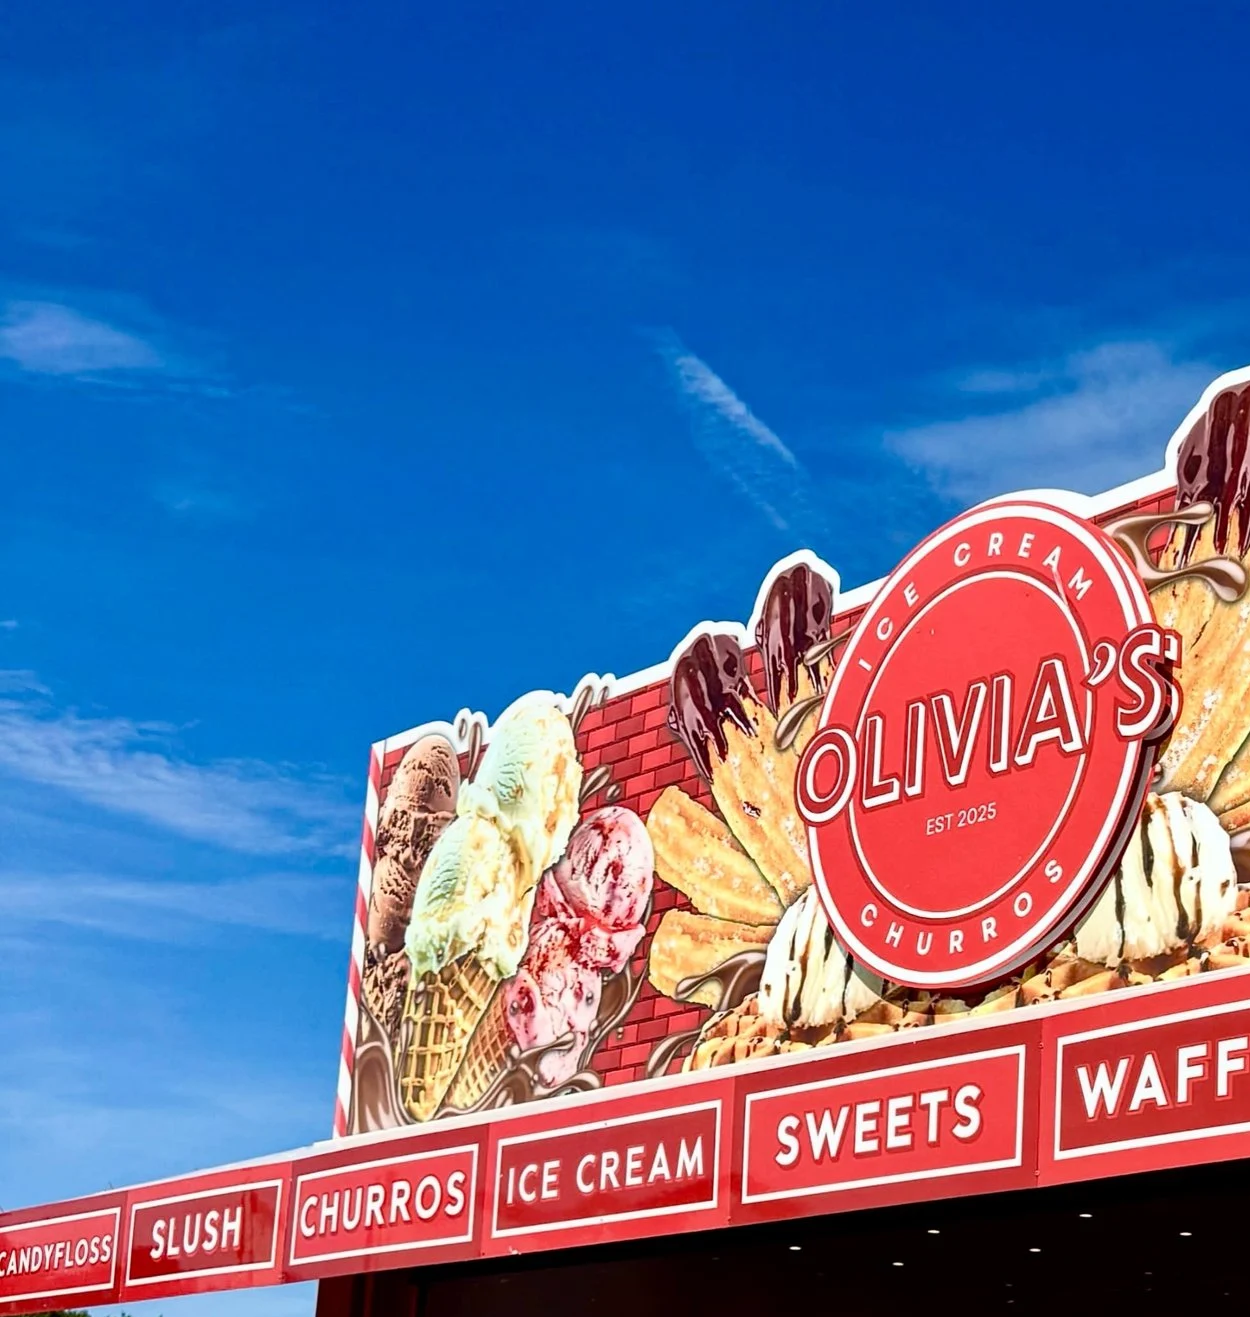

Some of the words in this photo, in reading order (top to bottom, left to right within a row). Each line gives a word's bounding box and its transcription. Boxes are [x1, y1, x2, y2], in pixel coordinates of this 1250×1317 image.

[857, 581, 918, 672] ICE
[953, 532, 1094, 601] CREAM
[797, 622, 1181, 826] OLIVIA'S
[925, 813, 952, 836] EST
[957, 802, 998, 830] 2025
[861, 858, 1063, 957] CHURROS
[776, 1083, 983, 1168] SWEETS
[300, 1170, 467, 1239] CHURROS
[505, 1160, 559, 1206] ICE
[575, 1134, 706, 1196] CREAM
[150, 1206, 243, 1260] SLUSH
